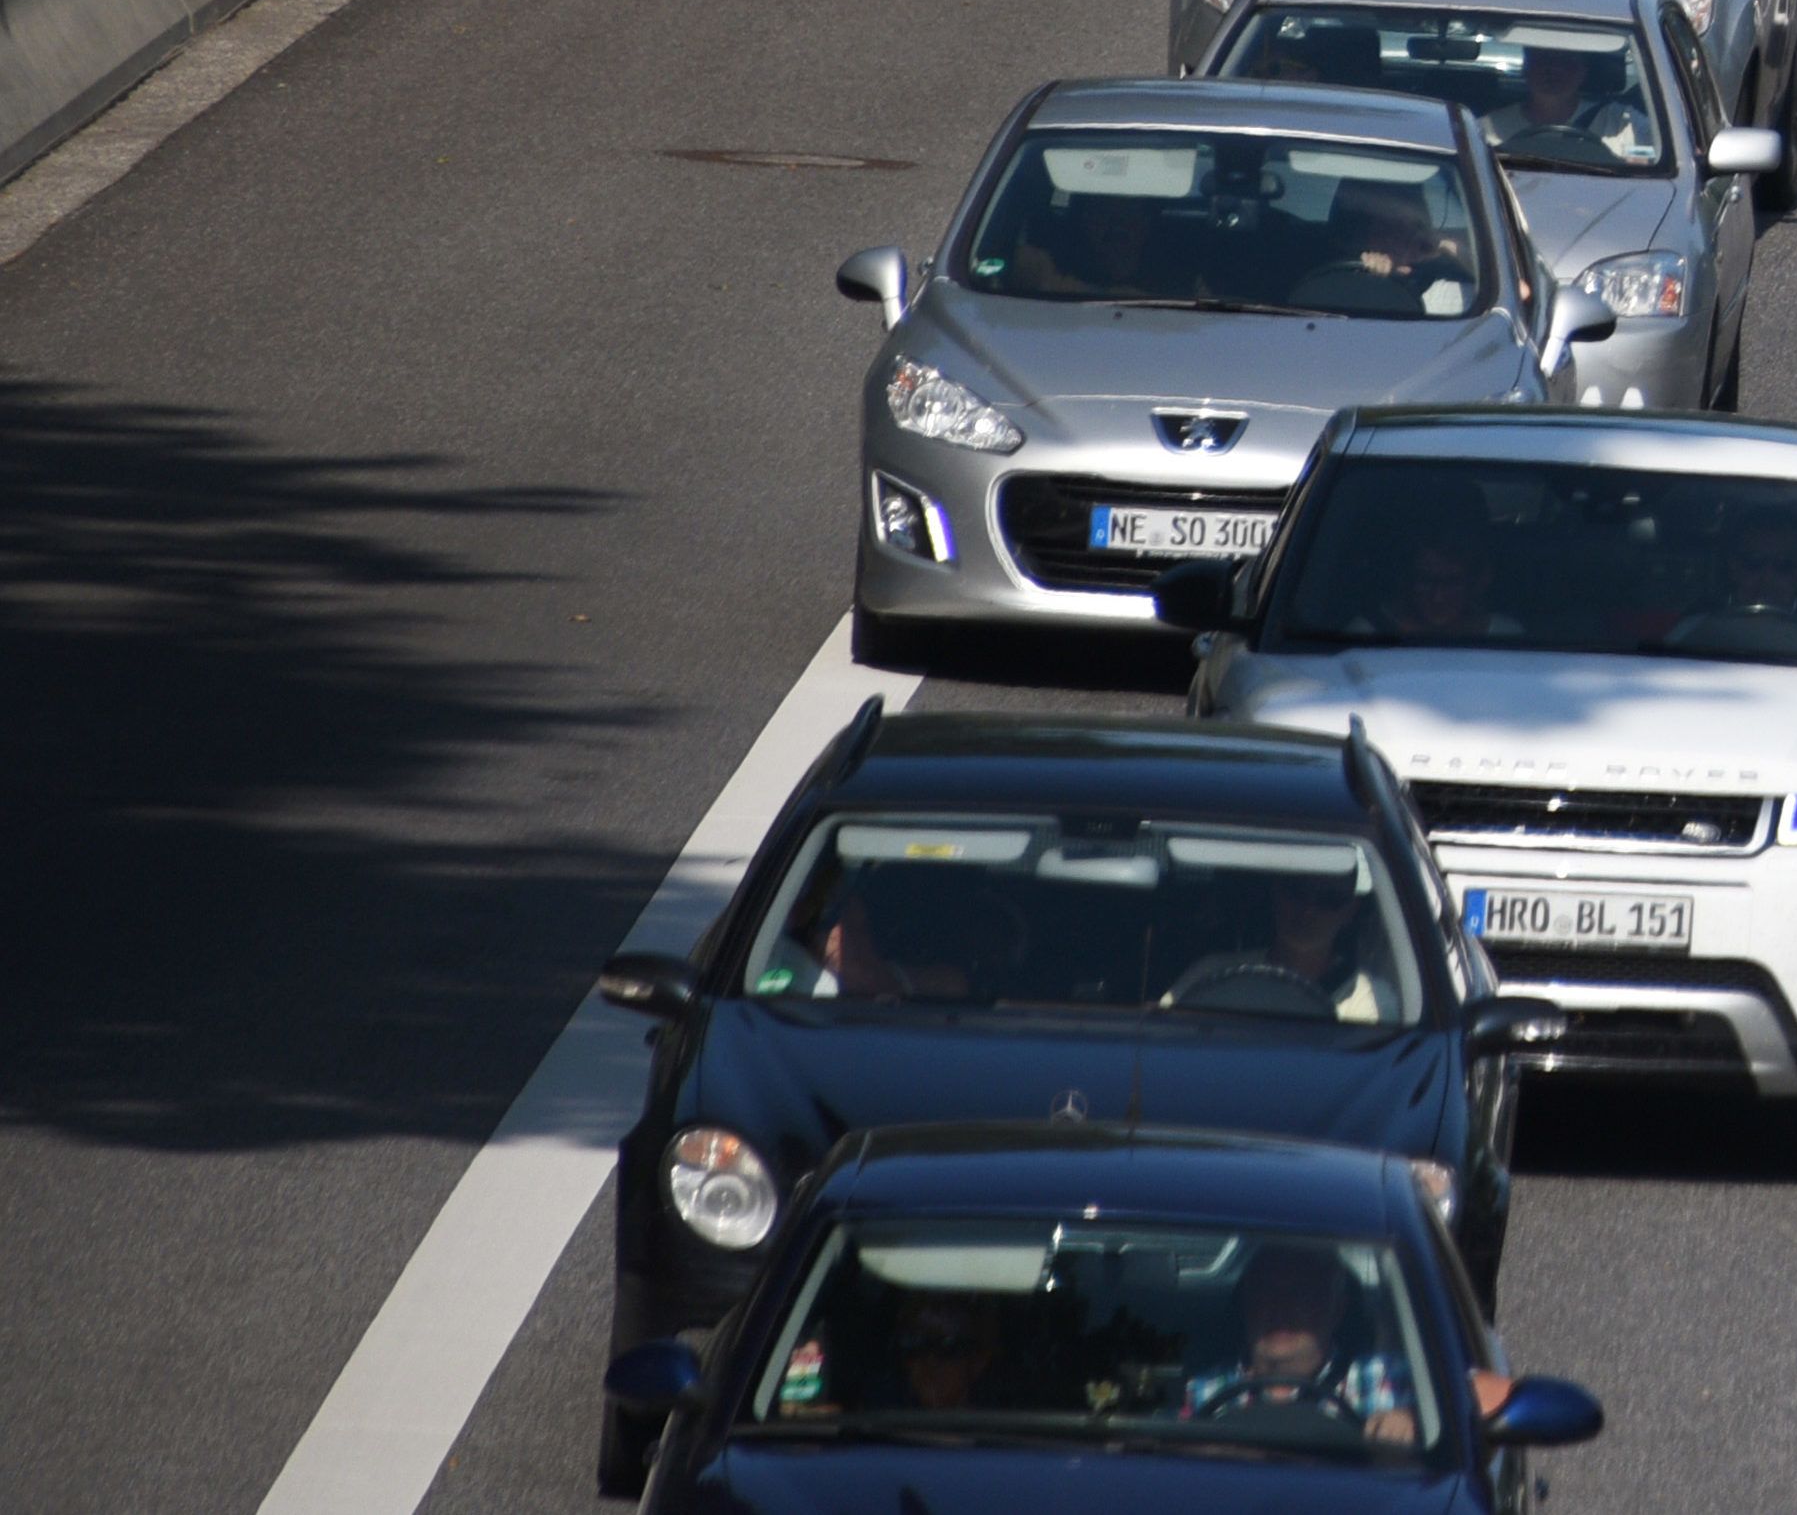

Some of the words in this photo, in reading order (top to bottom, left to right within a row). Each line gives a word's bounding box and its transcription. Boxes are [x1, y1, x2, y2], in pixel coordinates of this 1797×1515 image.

[1111, 513, 1147, 544] NE
[1170, 515, 1206, 547] SO
[1486, 895, 1550, 933] HRO
[1576, 899, 1617, 935] BL
[1628, 901, 1686, 938] 151
